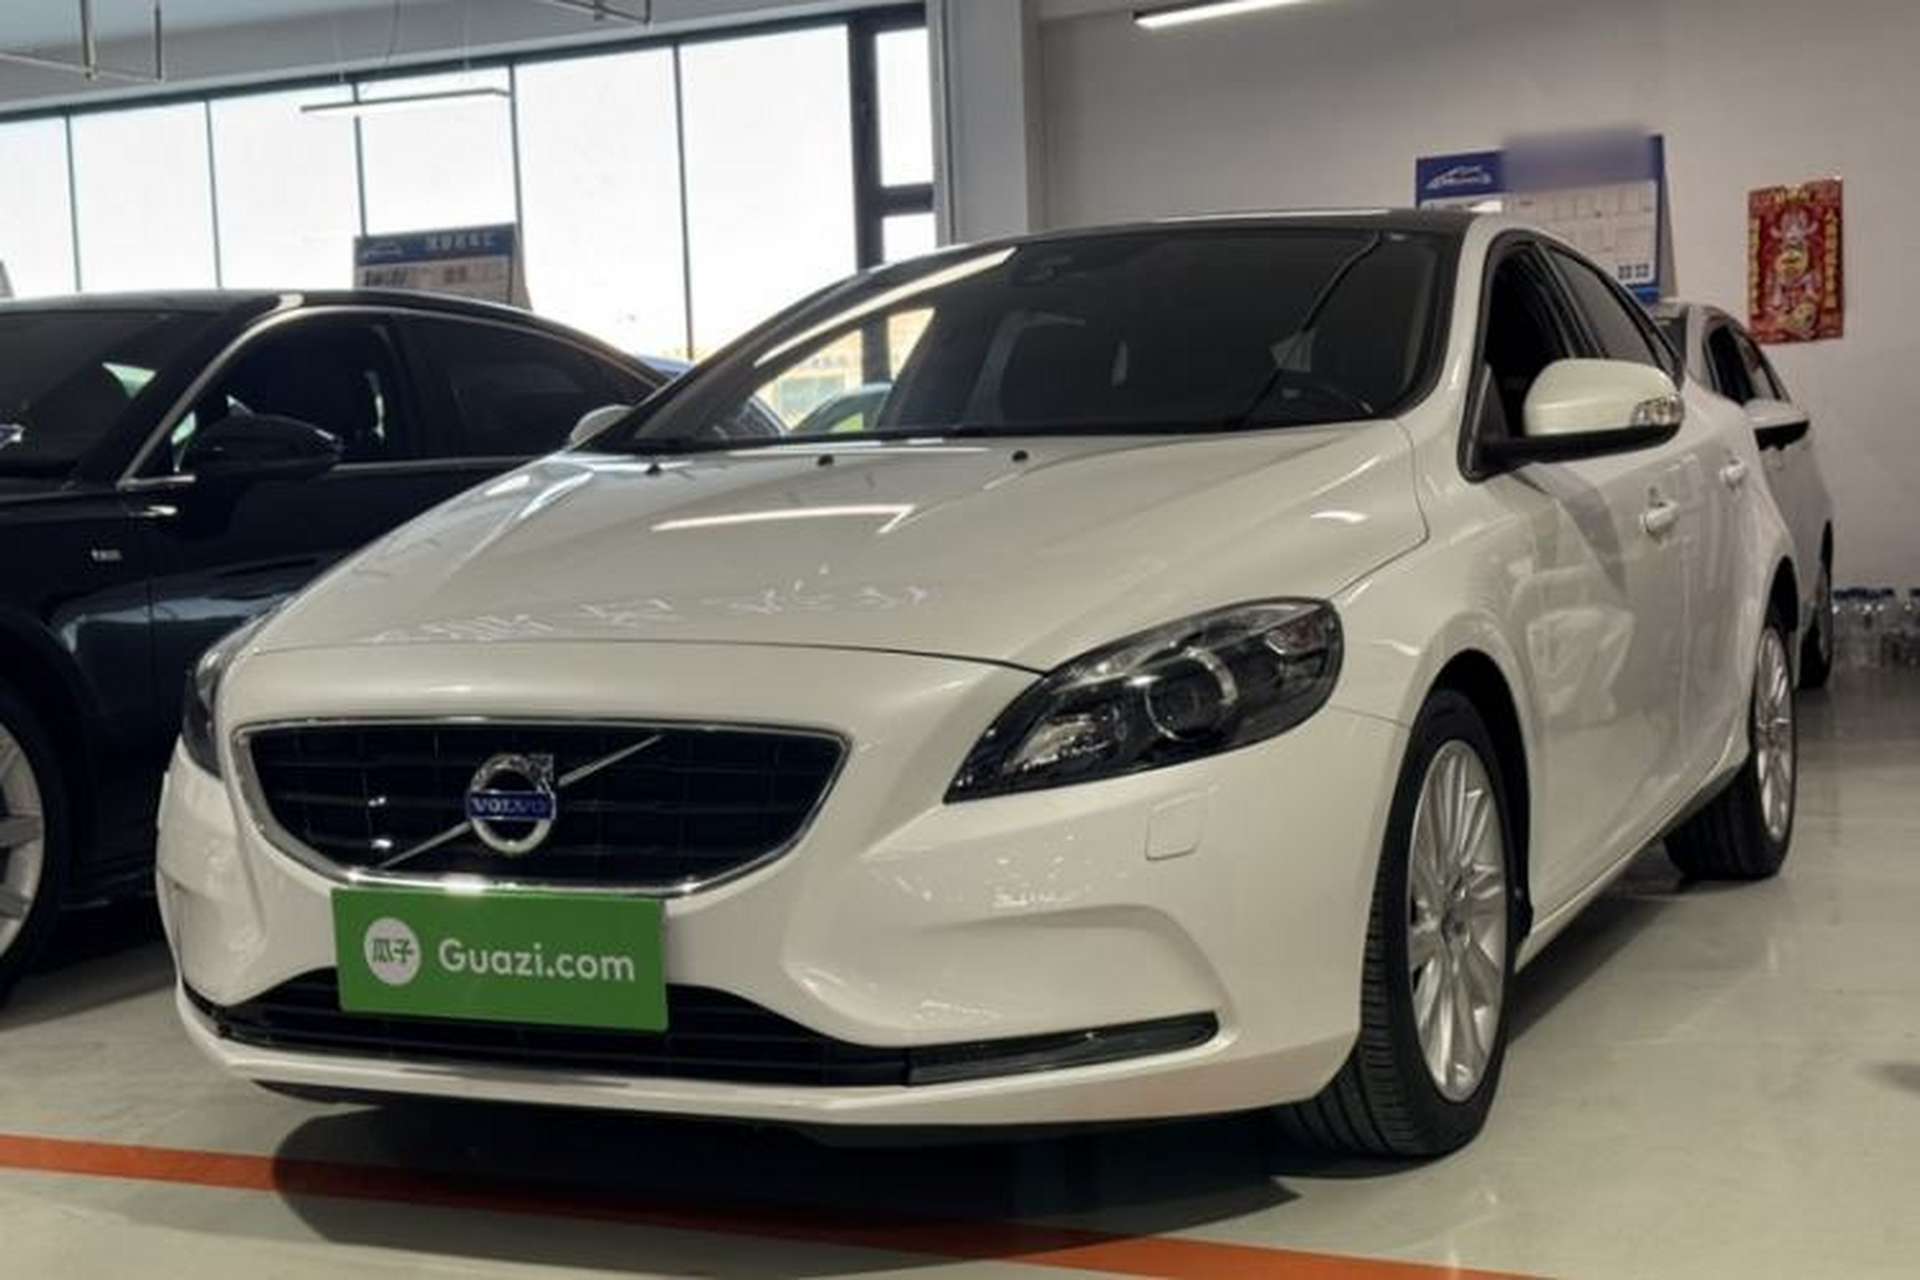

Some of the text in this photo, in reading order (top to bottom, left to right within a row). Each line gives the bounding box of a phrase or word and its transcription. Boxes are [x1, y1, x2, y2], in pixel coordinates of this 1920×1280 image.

[471, 797, 546, 813] VOLVO
[371, 938, 413, 964] 瓜子
[438, 937, 636, 982] Guazi.com
